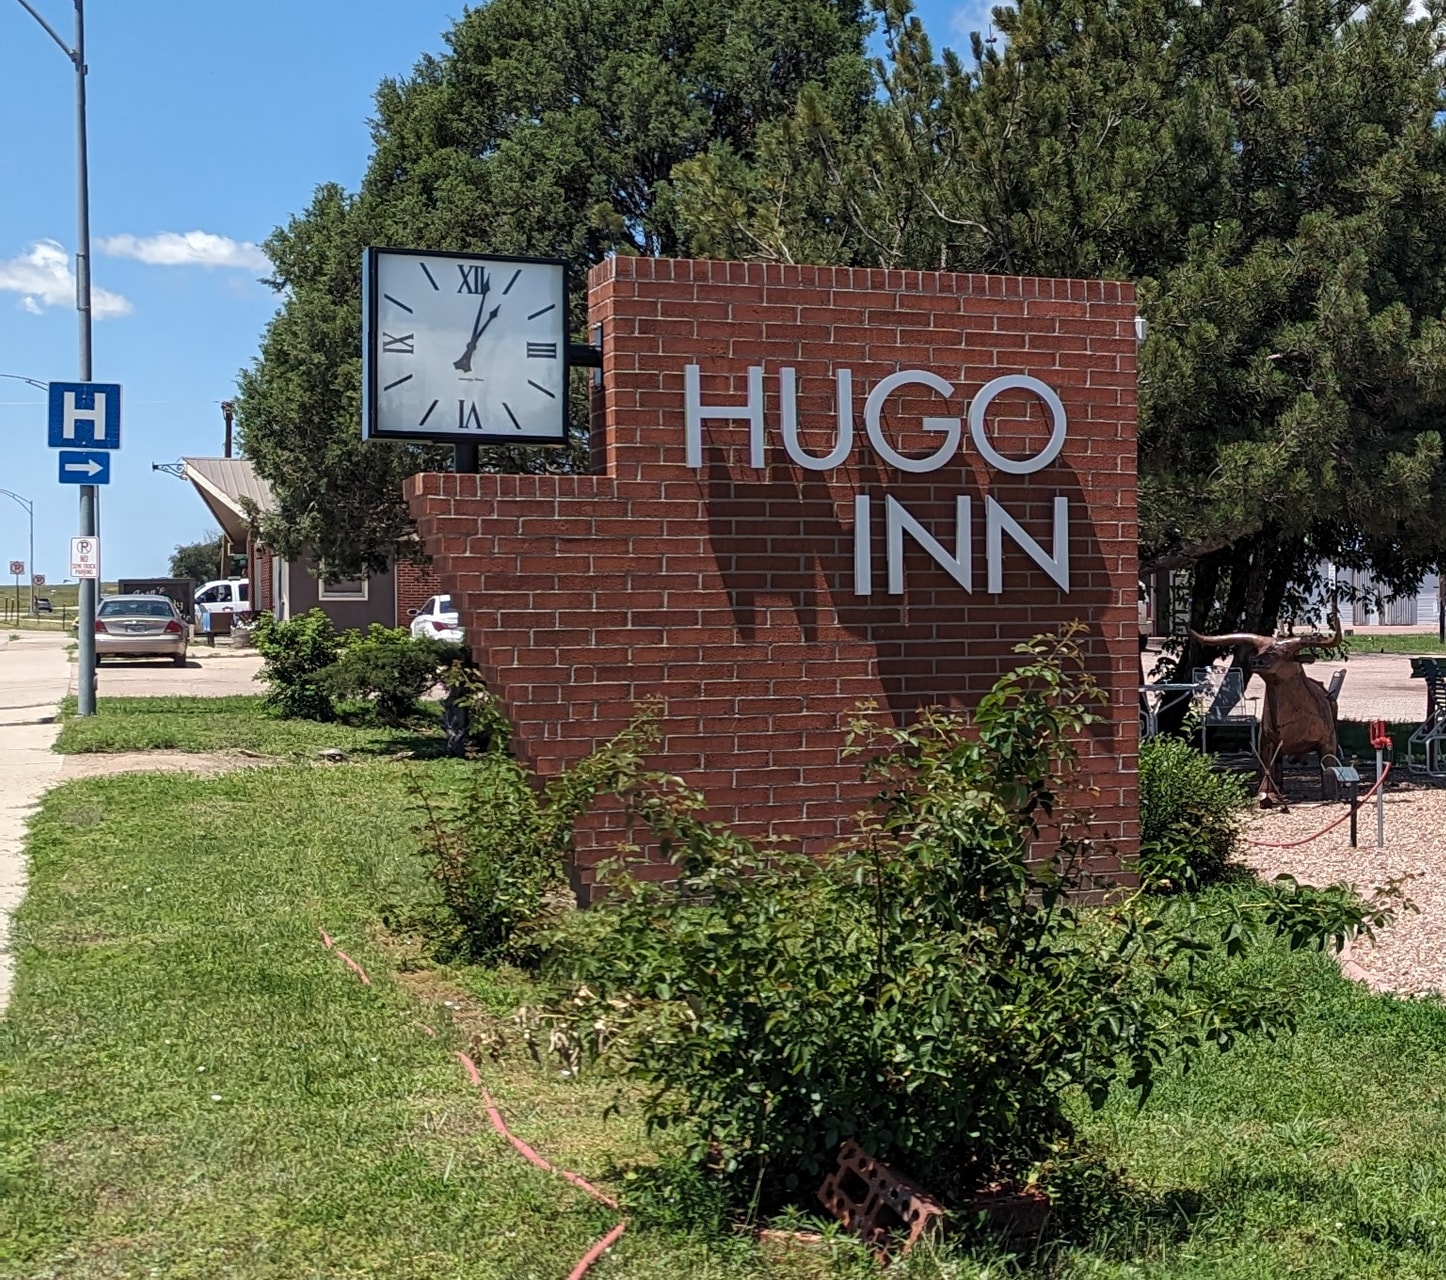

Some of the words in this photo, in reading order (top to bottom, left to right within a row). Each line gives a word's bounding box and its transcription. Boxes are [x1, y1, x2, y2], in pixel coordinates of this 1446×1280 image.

[457, 264, 485, 295] XII
[527, 341, 557, 359] III
[63, 391, 106, 440] H
[684, 364, 1067, 475] HUGO
[854, 493, 1070, 596] INN
